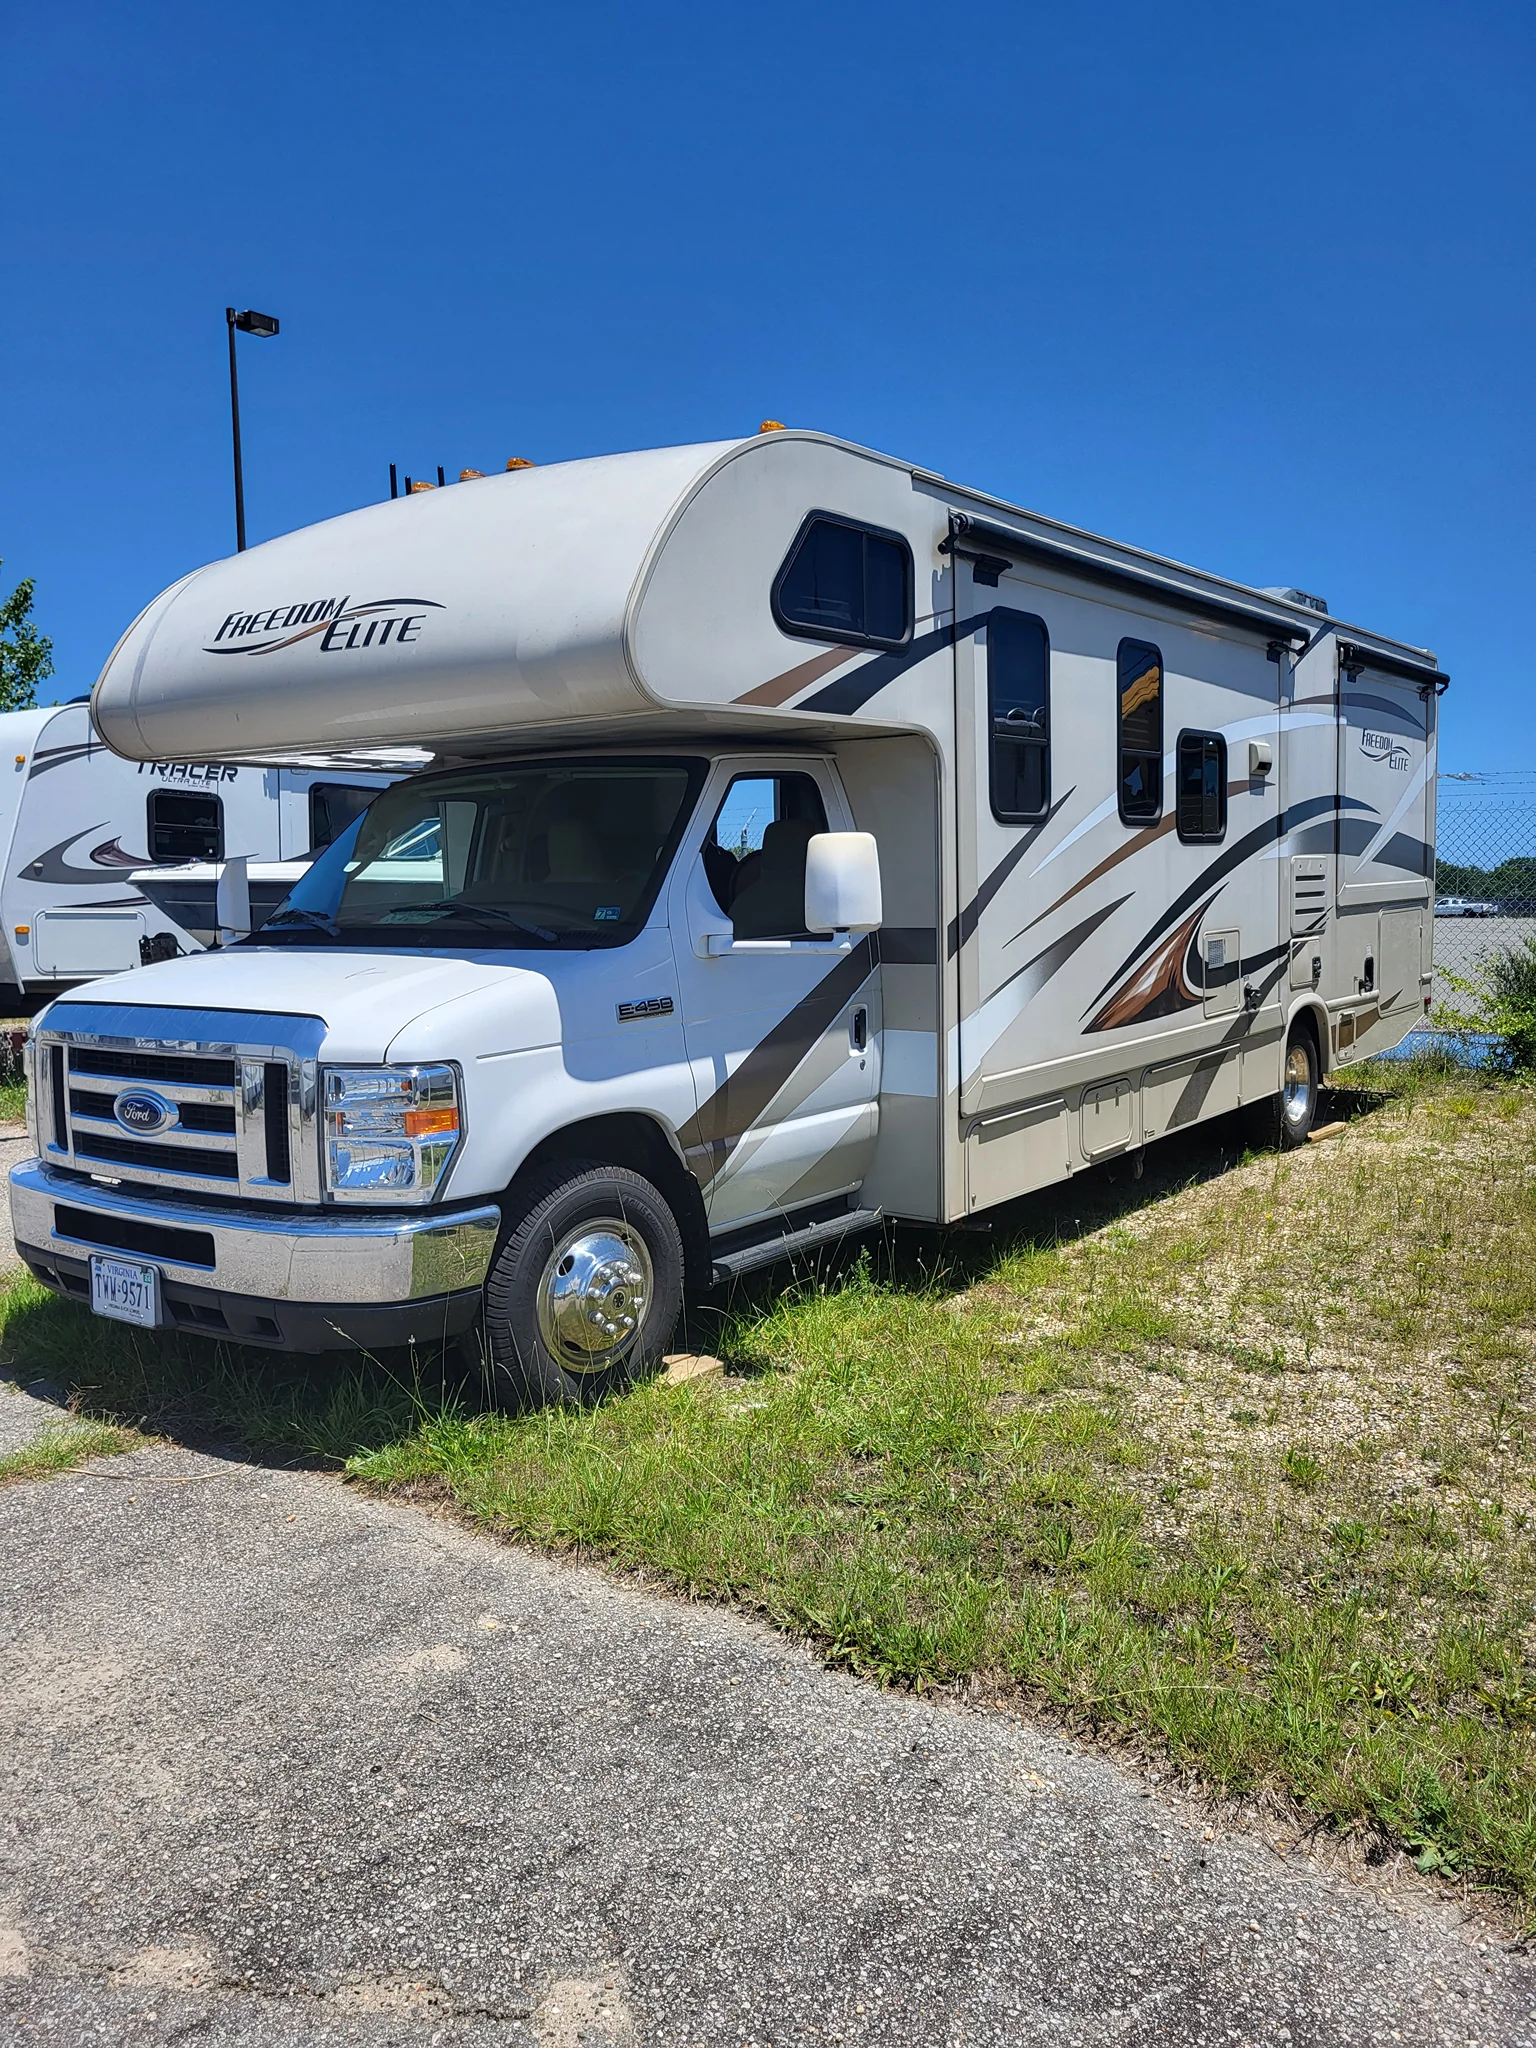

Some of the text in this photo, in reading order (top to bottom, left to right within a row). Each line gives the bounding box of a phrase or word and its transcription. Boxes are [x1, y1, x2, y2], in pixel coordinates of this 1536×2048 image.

[213, 595, 351, 642] FREEDOM
[319, 615, 427, 653] ELITE
[1361, 728, 1394, 752] FREEDOM
[138, 762, 238, 783] TRACER
[1389, 752, 1409, 772] ELITE
[162, 776, 190, 784] ULTRA
[124, 1101, 151, 1122] Ford
[107, 1264, 138, 1280] VIRGINIA
